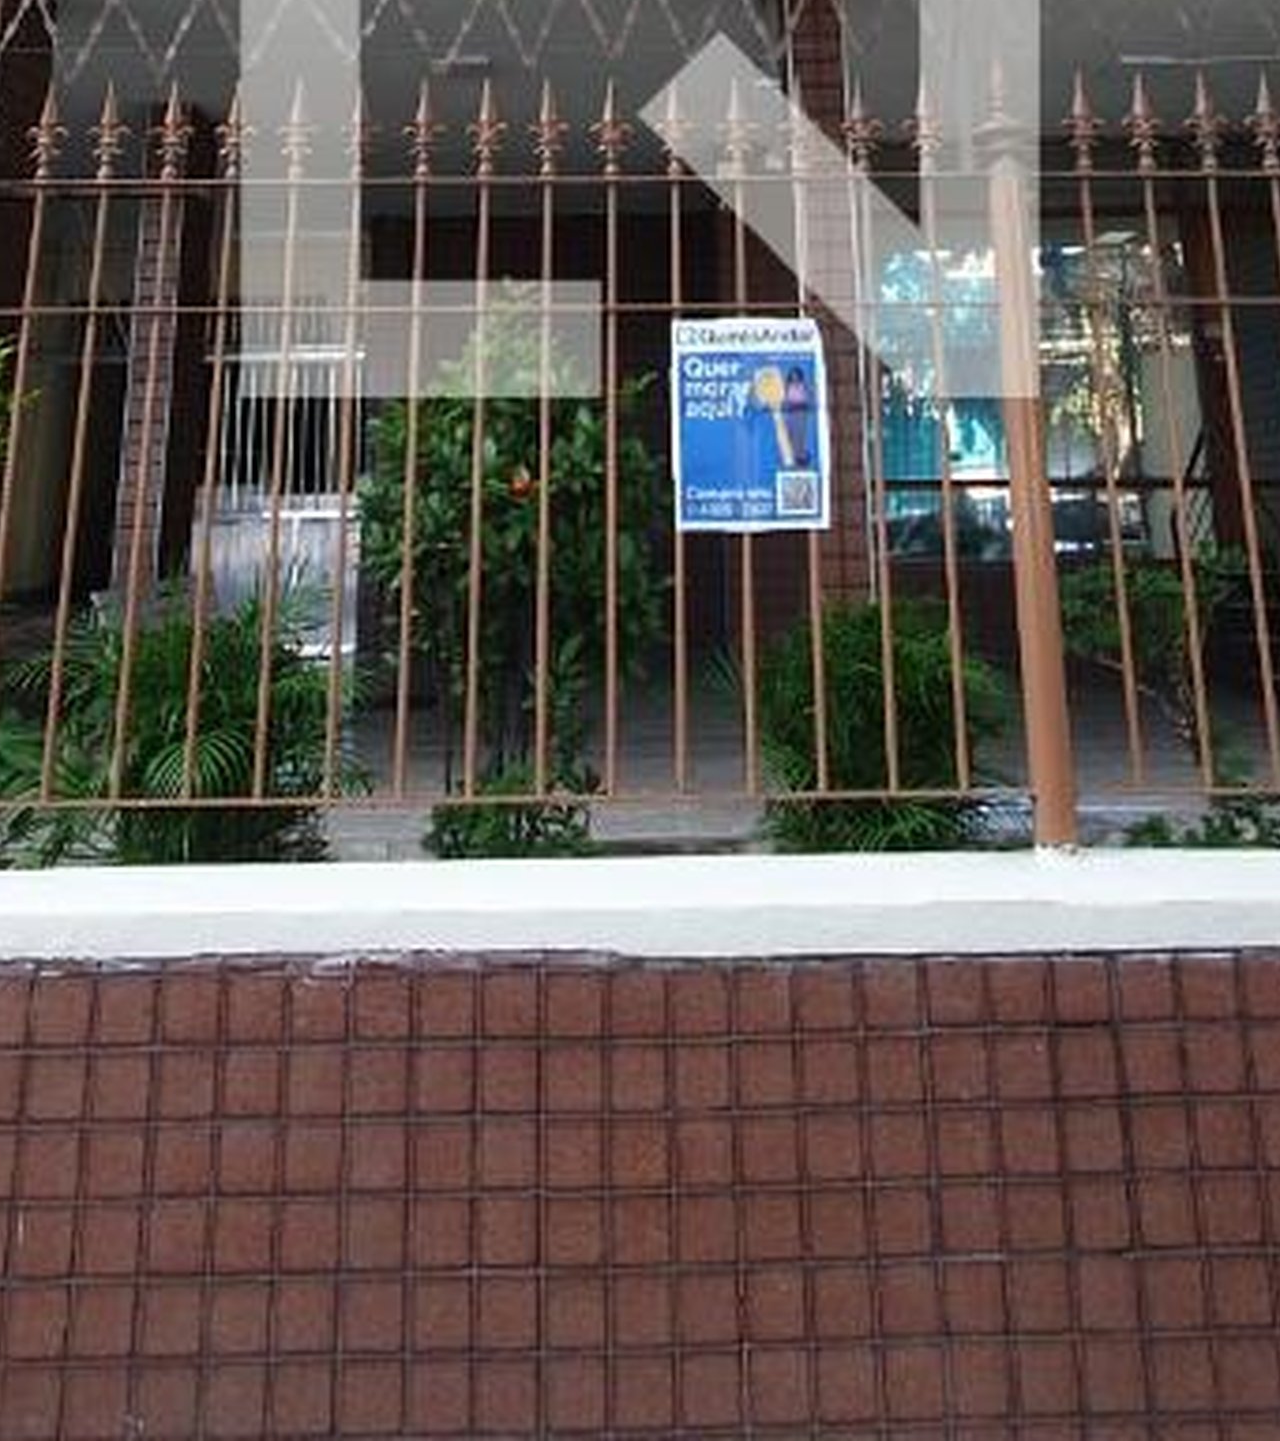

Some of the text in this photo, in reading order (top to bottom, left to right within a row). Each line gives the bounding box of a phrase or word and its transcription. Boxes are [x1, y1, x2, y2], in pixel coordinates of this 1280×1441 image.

[683, 357, 740, 378] Quer
[684, 381, 750, 398] morar
[685, 398, 747, 421] aqui?
